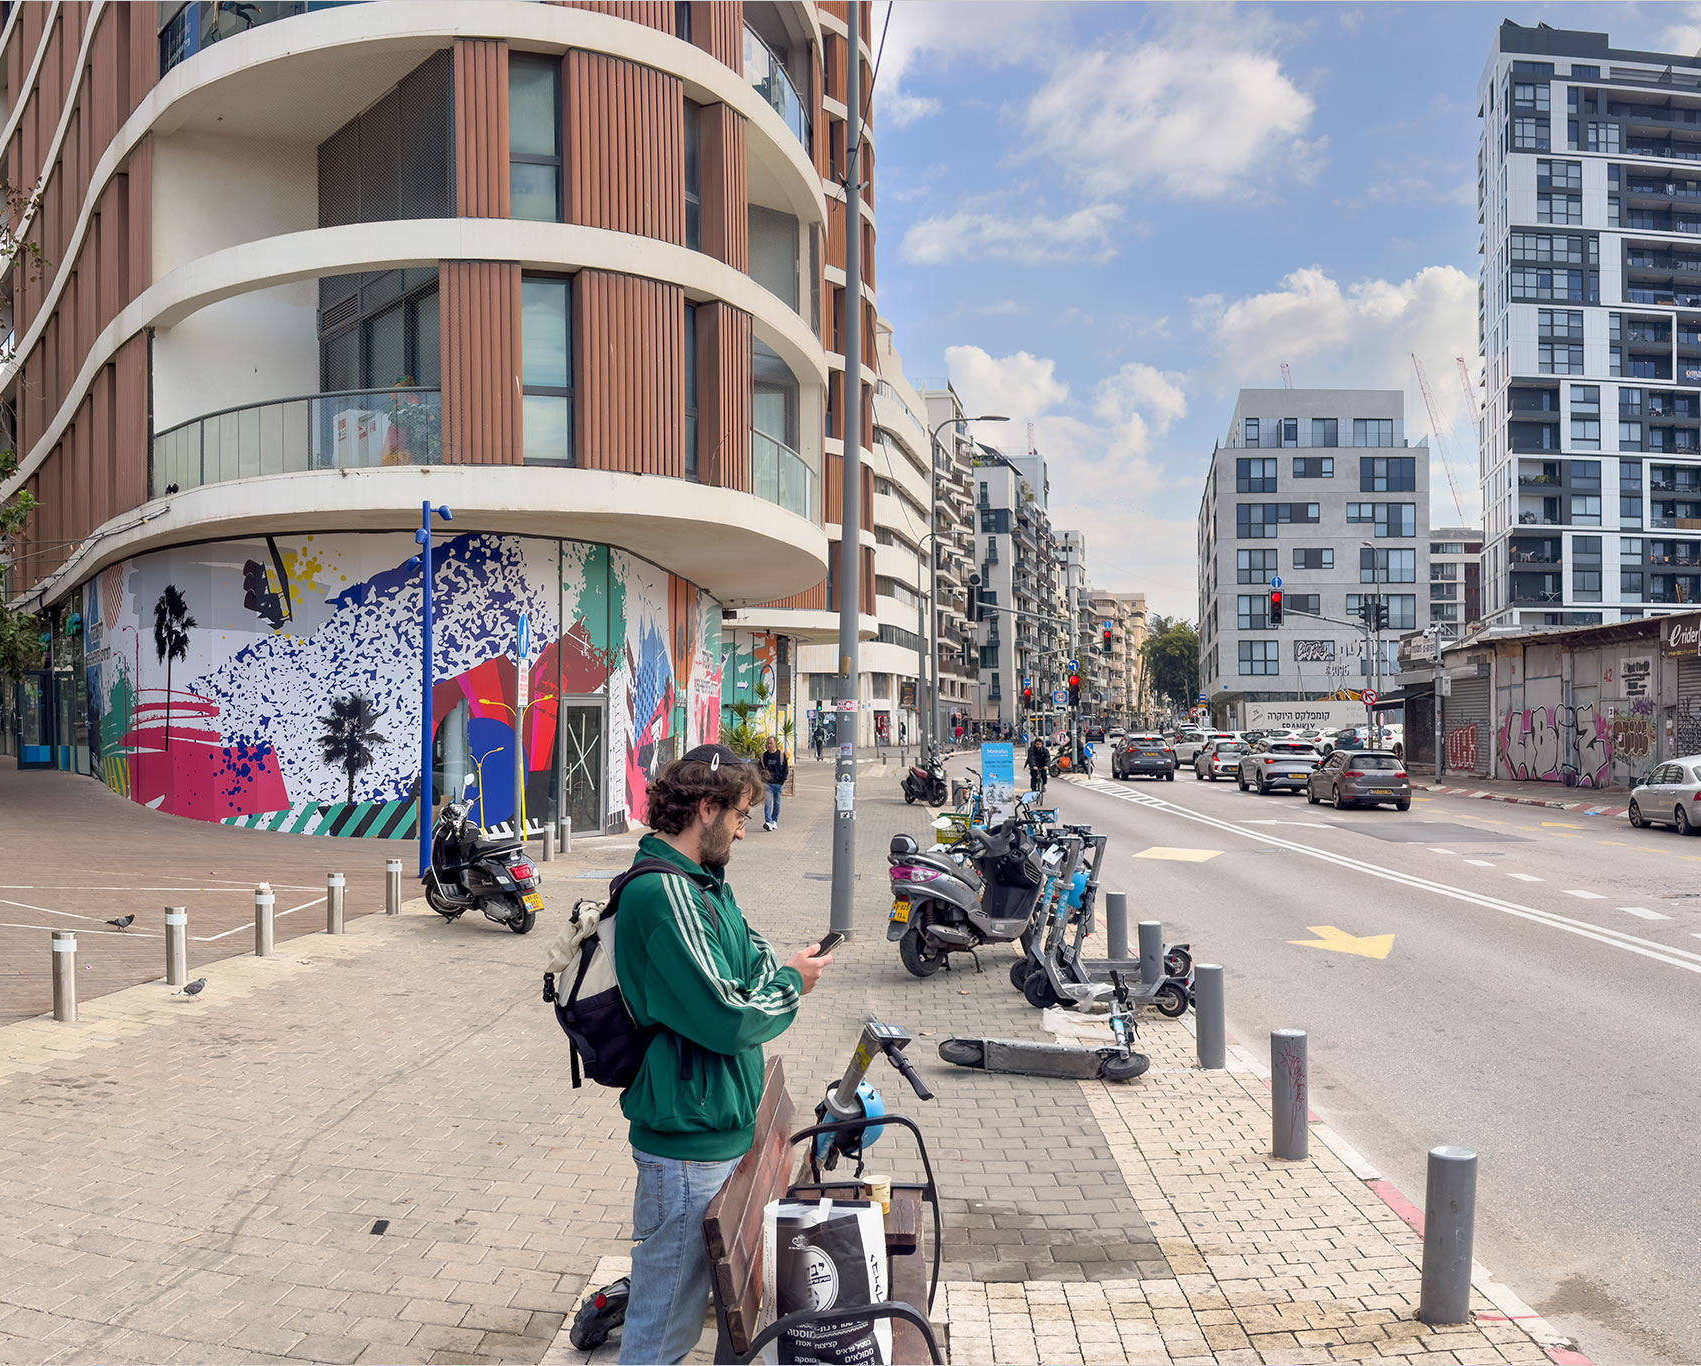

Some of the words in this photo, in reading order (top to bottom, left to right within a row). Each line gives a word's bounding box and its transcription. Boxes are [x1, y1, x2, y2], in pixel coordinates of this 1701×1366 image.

[1603, 668, 1613, 682] 42
[1267, 711, 1294, 721] היוקרה
[1295, 709, 1331, 721] קומפלקס
[844, 1347, 875, 1363] ממולאים
